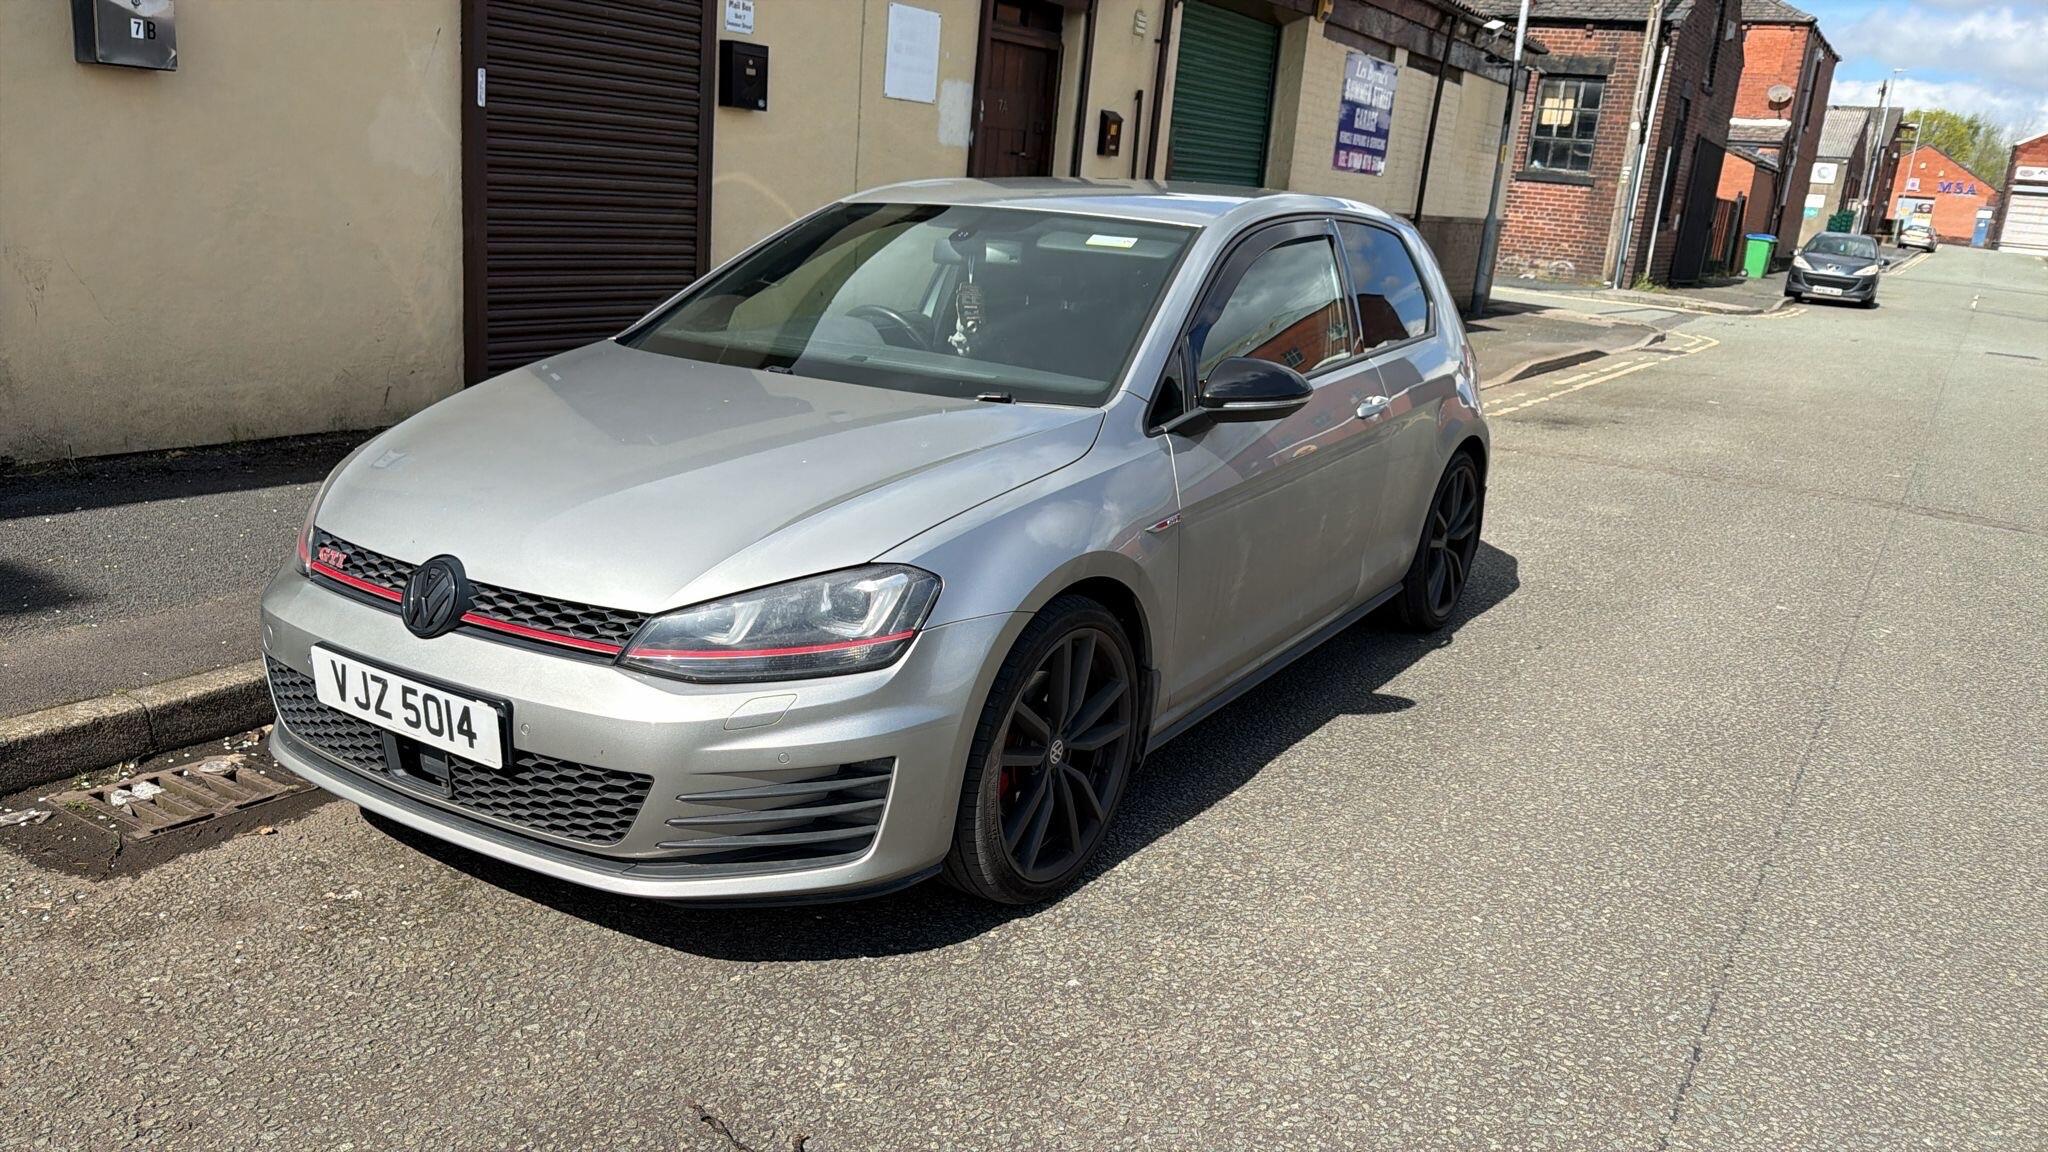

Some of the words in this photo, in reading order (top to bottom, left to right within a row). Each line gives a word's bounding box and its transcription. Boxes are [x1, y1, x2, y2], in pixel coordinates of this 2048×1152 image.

[1372, 86, 1393, 110] STREET
[318, 546, 347, 569] GTI
[330, 659, 393, 720] VJZ
[401, 684, 478, 749] 5014
